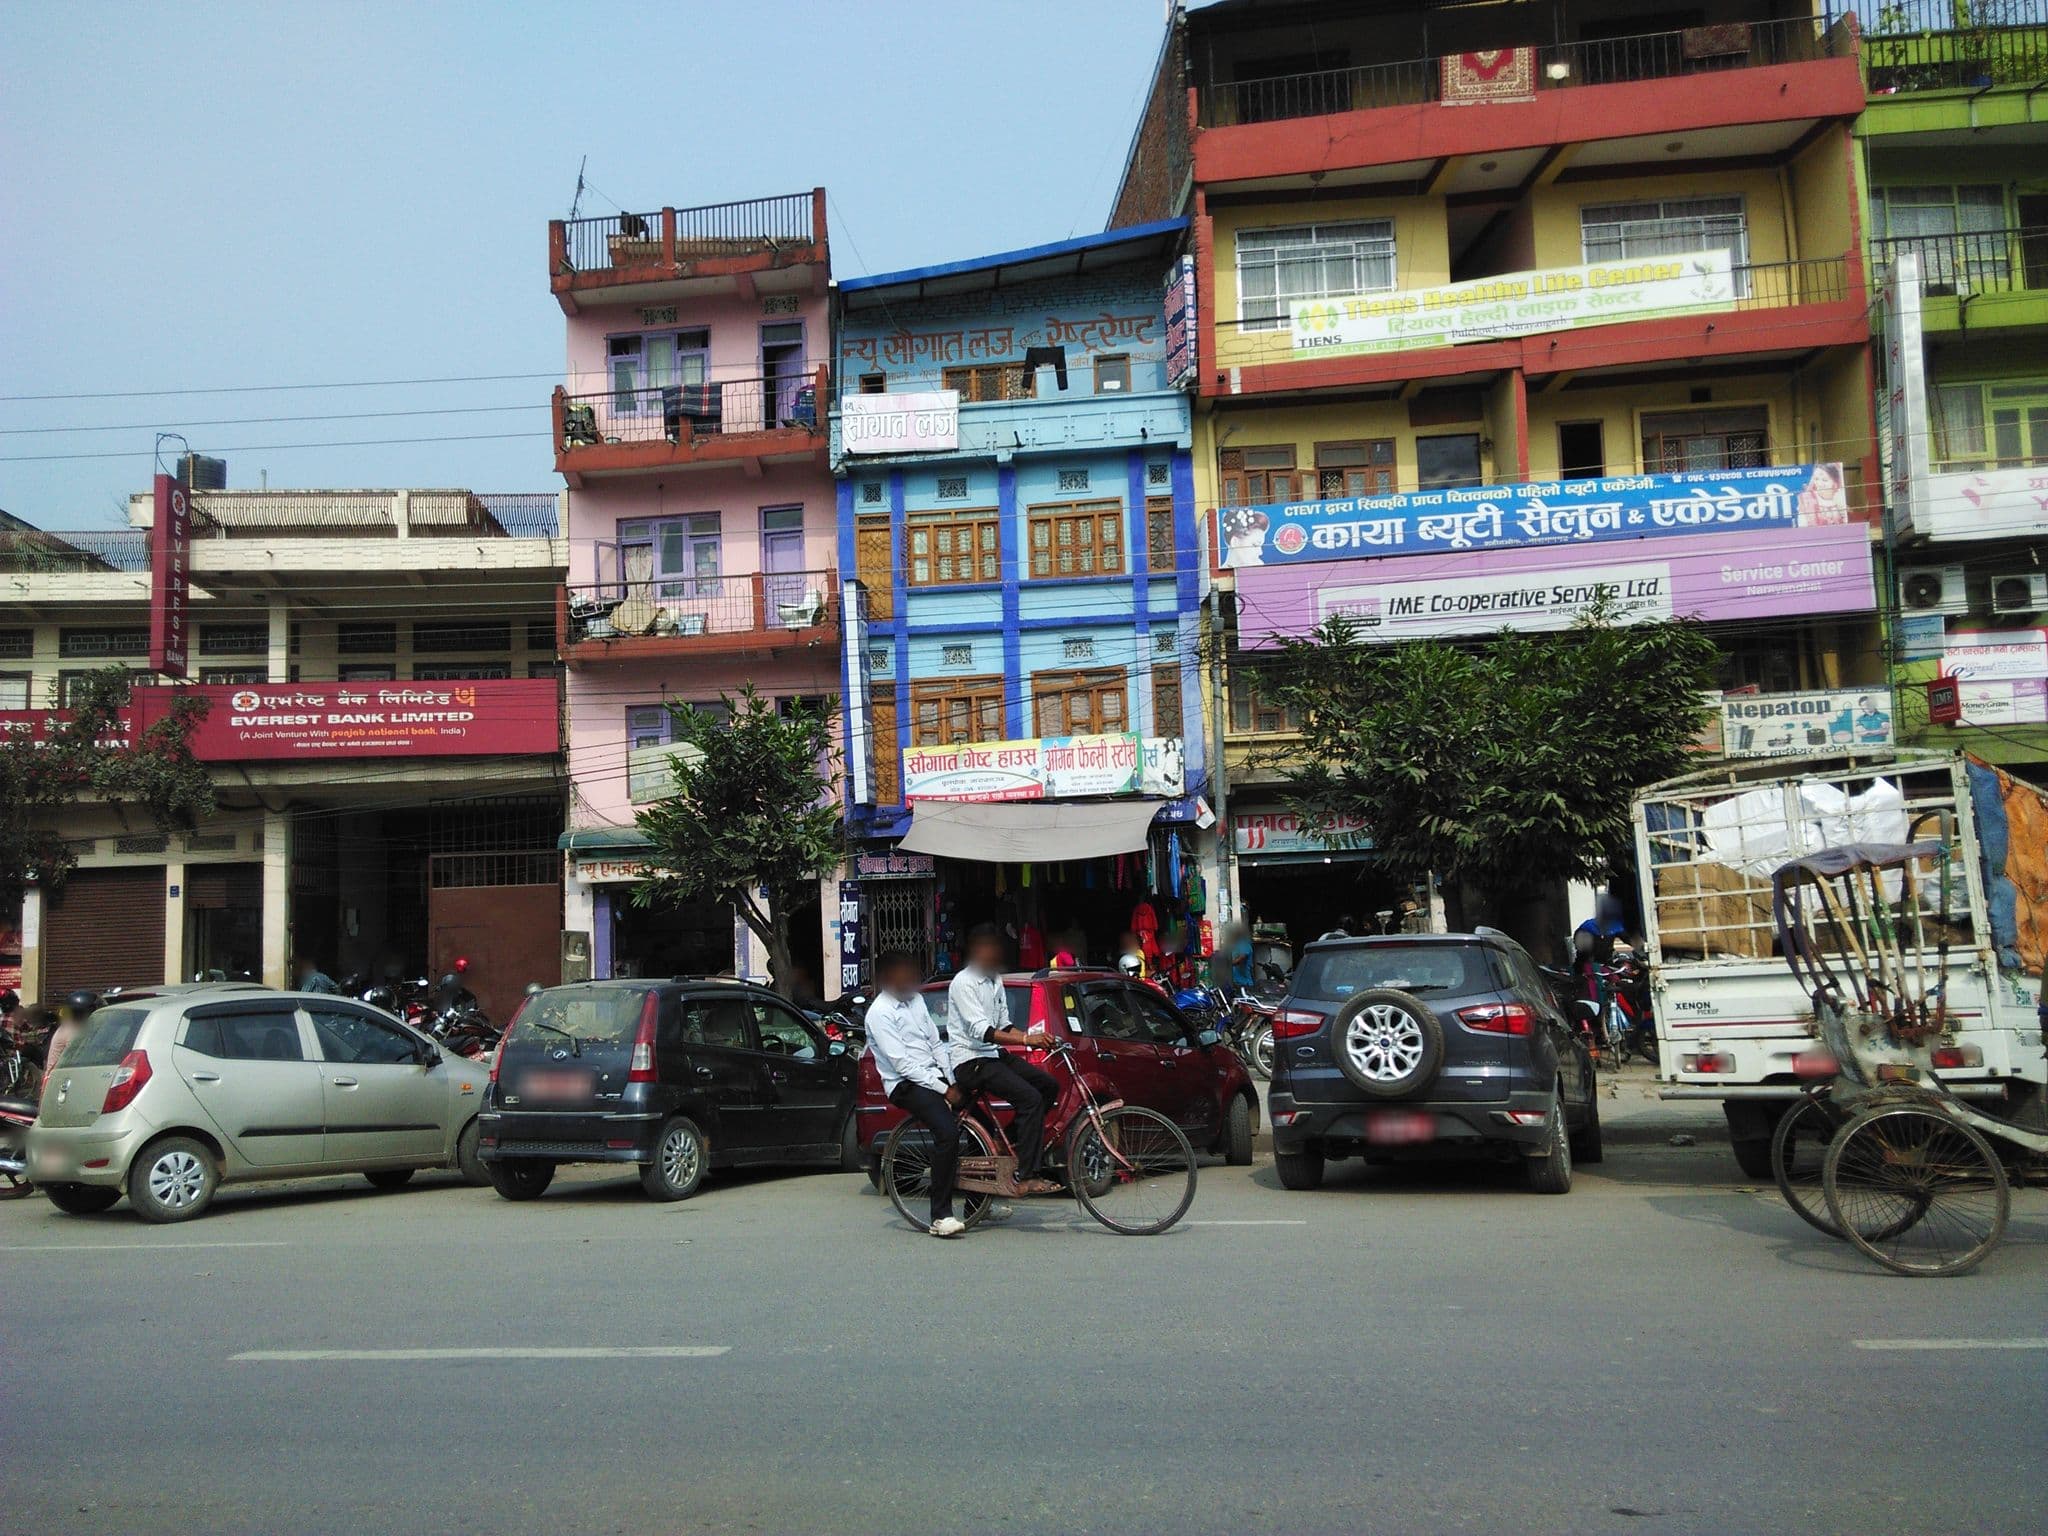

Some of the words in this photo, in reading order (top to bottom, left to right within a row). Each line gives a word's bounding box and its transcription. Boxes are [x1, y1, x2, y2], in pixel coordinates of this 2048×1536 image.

[1299, 335, 1342, 349] TIENS
[1284, 503, 1321, 516] CTEVT
[1312, 517, 1406, 550] काया
[1516, 498, 1623, 539] सैलुन
[1627, 509, 1646, 525] &
[1649, 483, 1794, 526] एकेडेमी
[1721, 563, 1783, 584] Service
[1788, 558, 1845, 580] Center
[173, 519, 182, 648] EVEREST
[1389, 596, 1425, 616] IME
[1431, 589, 1546, 615] Co-operative
[1627, 578, 1663, 597] Ltd.
[337, 689, 368, 705] बैंक
[379, 689, 452, 705] लिमिटेड
[1728, 700, 1831, 719] Nepatop
[231, 715, 321, 727] EVEREST
[328, 714, 385, 725] BANK
[391, 712, 474, 723] LIMITED
[252, 731, 273, 739] Joint
[275, 730, 307, 739] Venture
[310, 730, 329, 738] With
[331, 728, 366, 739] punjab
[368, 728, 409, 736] national
[964, 748, 992, 768] गेष्ट
[998, 749, 1037, 768] हाउस
[1675, 1001, 1711, 1010] XENON
